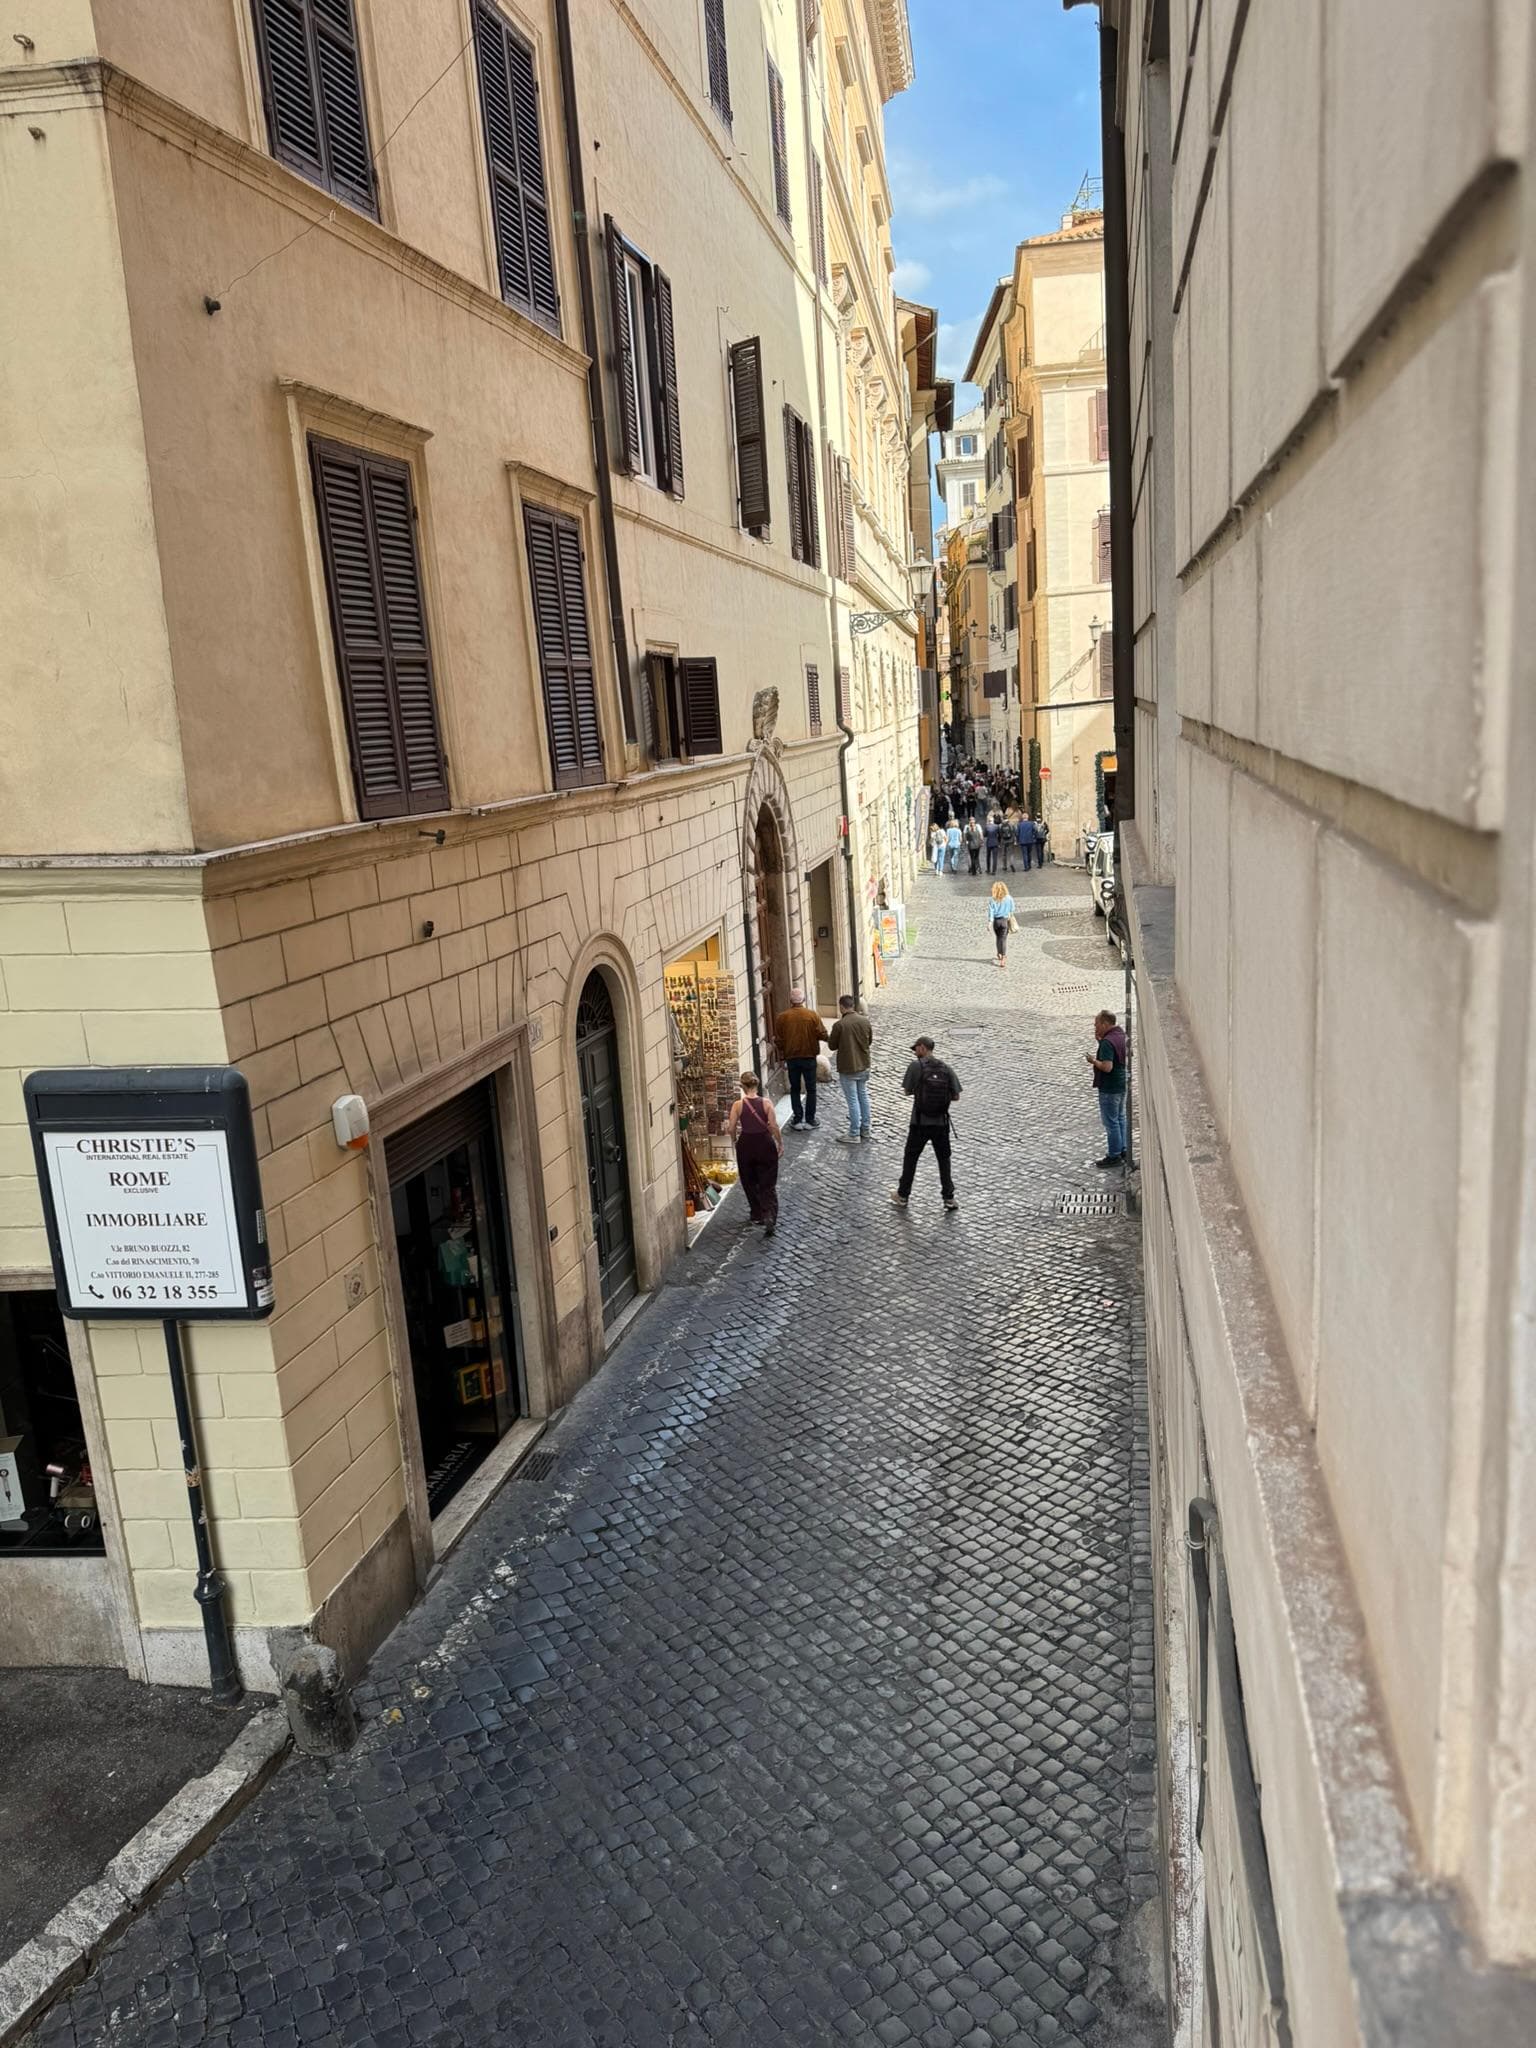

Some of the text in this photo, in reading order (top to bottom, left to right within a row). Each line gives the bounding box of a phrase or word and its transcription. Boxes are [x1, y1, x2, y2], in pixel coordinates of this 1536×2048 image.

[109, 1172, 170, 1187] ROME
[86, 1213, 208, 1227] IMMOBILIARE
[124, 1245, 150, 1253] BRUNO
[151, 1245, 182, 1253] BUOZZI,
[182, 1244, 190, 1252] 82
[131, 1258, 191, 1266] RINASCIMENTO,
[105, 1271, 142, 1279] VITTORIO
[143, 1271, 184, 1279] EMANUELE
[195, 1270, 219, 1279] 277-285
[112, 1285, 218, 1299] 06 32 18 355
